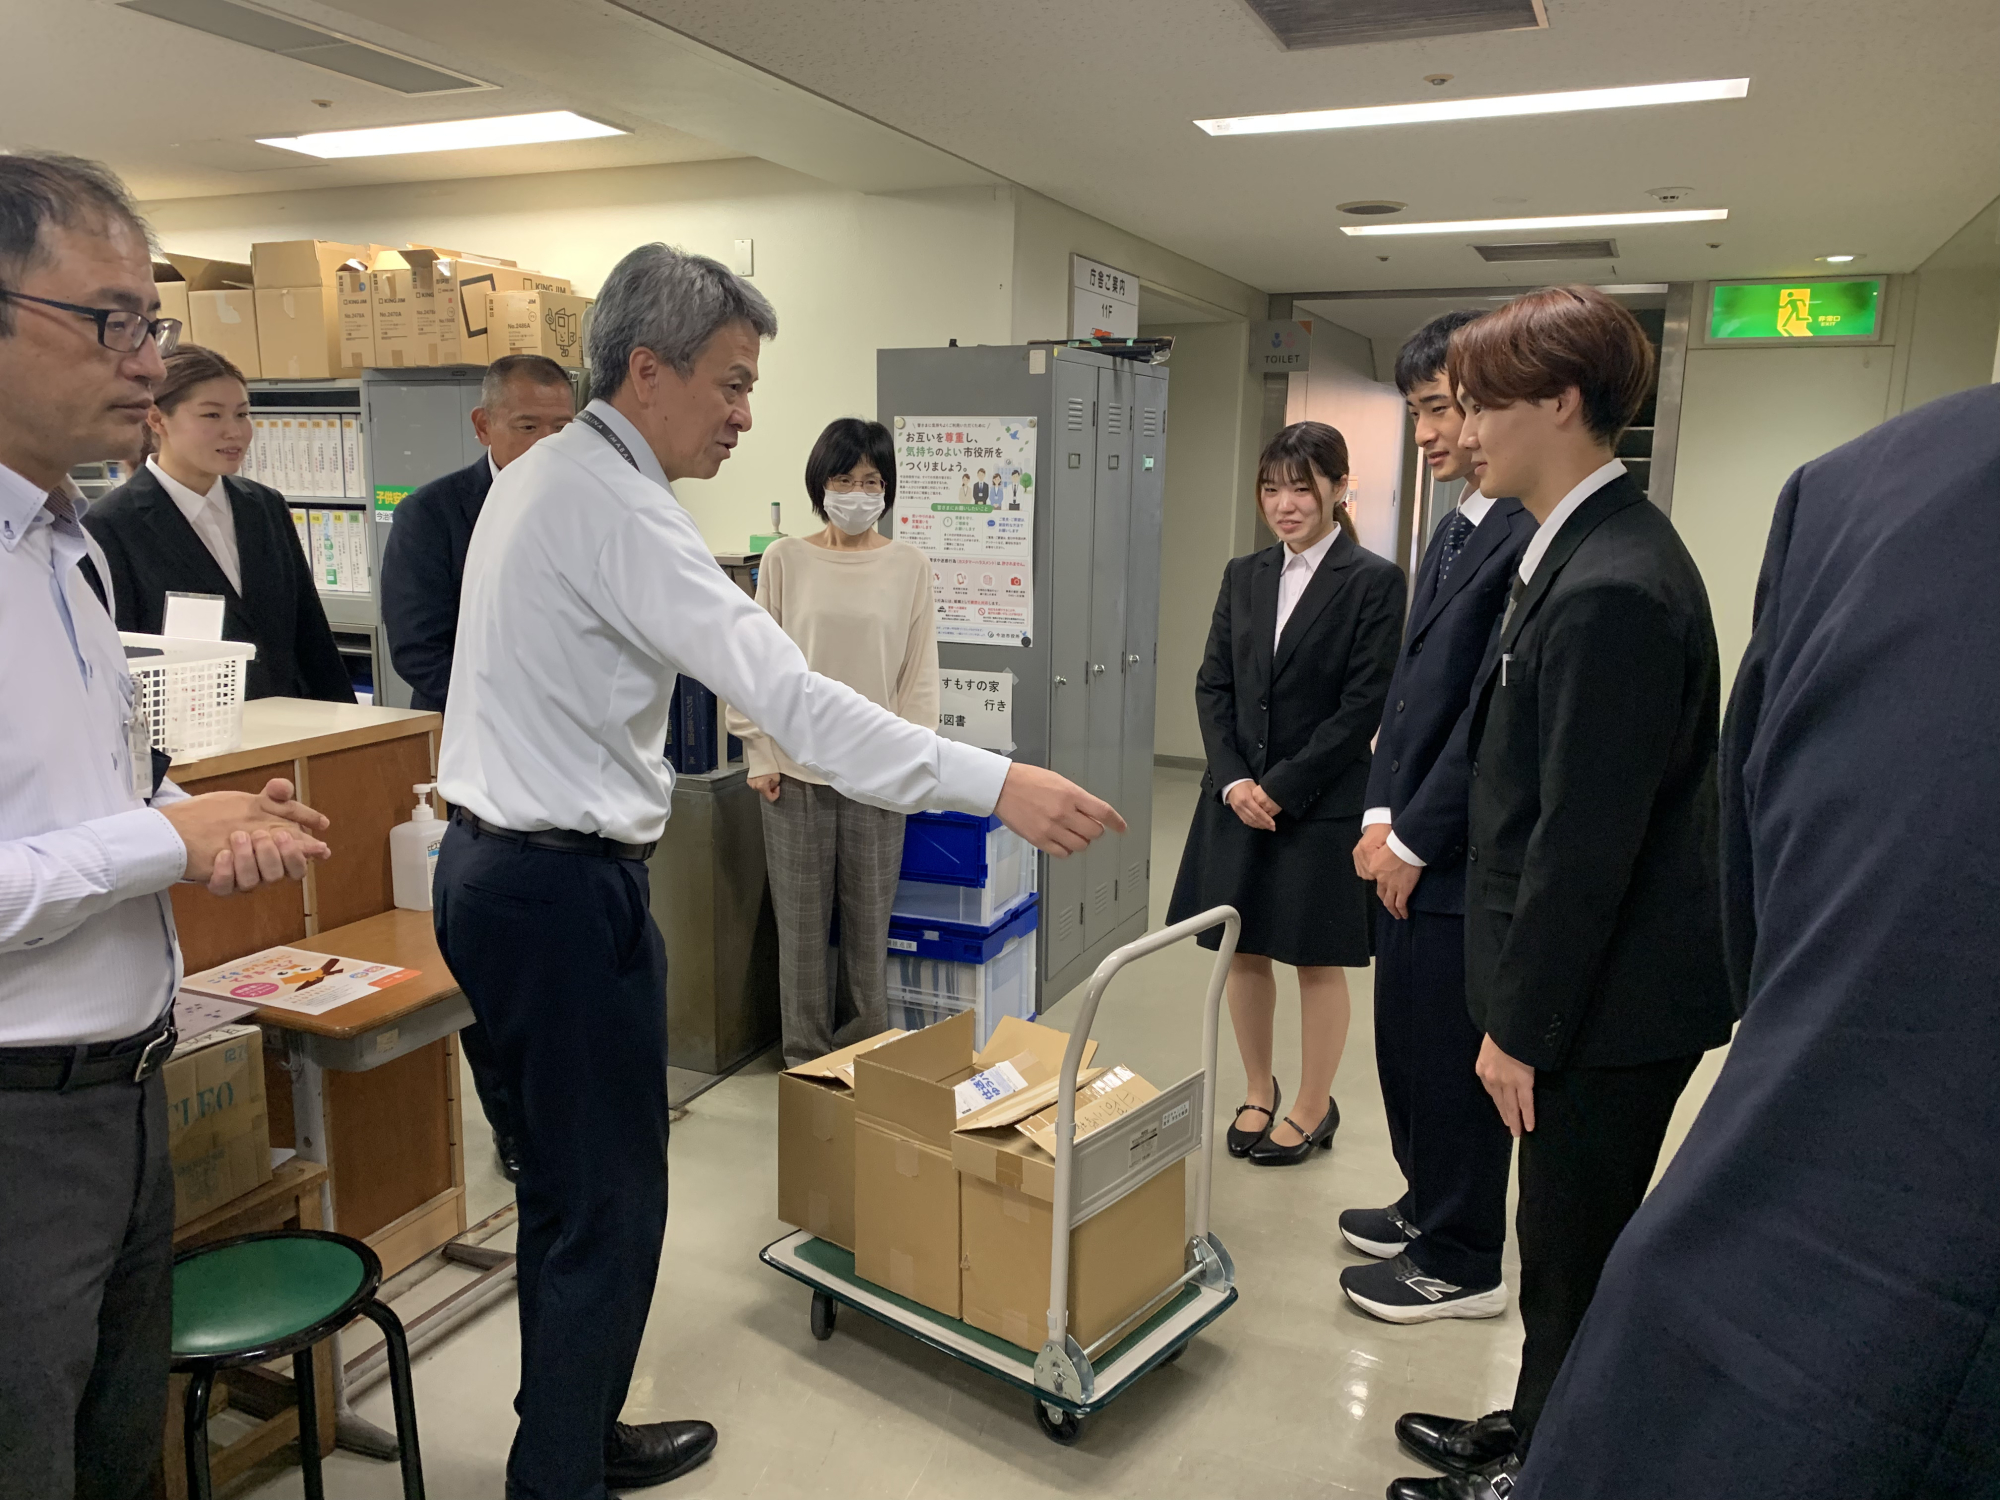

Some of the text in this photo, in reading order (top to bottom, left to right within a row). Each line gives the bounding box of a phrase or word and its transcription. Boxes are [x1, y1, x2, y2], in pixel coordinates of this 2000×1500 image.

[1089, 268, 1126, 297] 庁舎ご案内
[1101, 303, 1113, 319] 11F
[1265, 354, 1300, 364] TOILET
[906, 432, 978, 443] お互いを尊重し、
[906, 446, 1003, 458] 気持ちのよい市役所を
[906, 461, 967, 473] つくりましょう。
[941, 677, 1000, 693] すもすの家
[984, 699, 1006, 712] 行き
